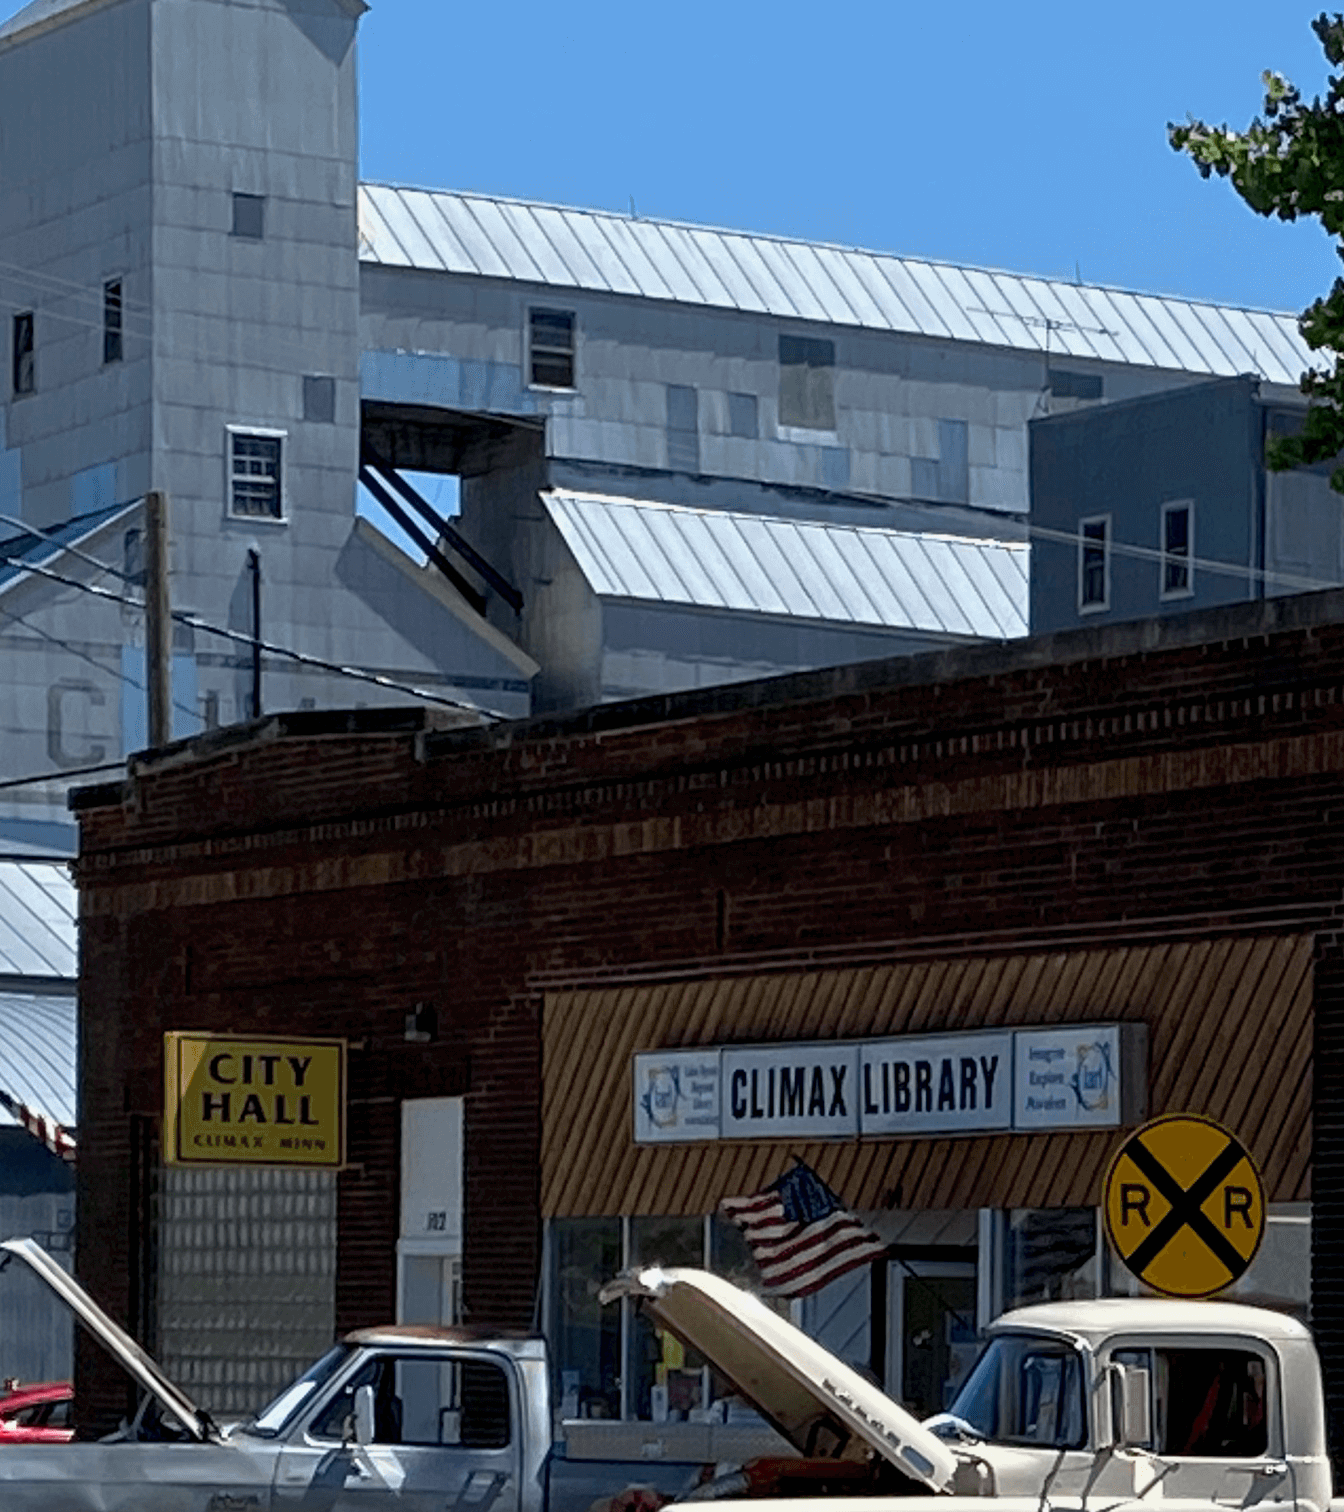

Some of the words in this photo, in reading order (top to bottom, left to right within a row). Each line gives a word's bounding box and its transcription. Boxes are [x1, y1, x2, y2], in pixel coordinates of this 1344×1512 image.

[208, 1053, 313, 1087] CITY
[731, 1064, 848, 1120] CLIMAX
[863, 1055, 999, 1115] LIBRARY
[201, 1092, 320, 1126] HALL
[193, 1134, 263, 1149] CLIMAX
